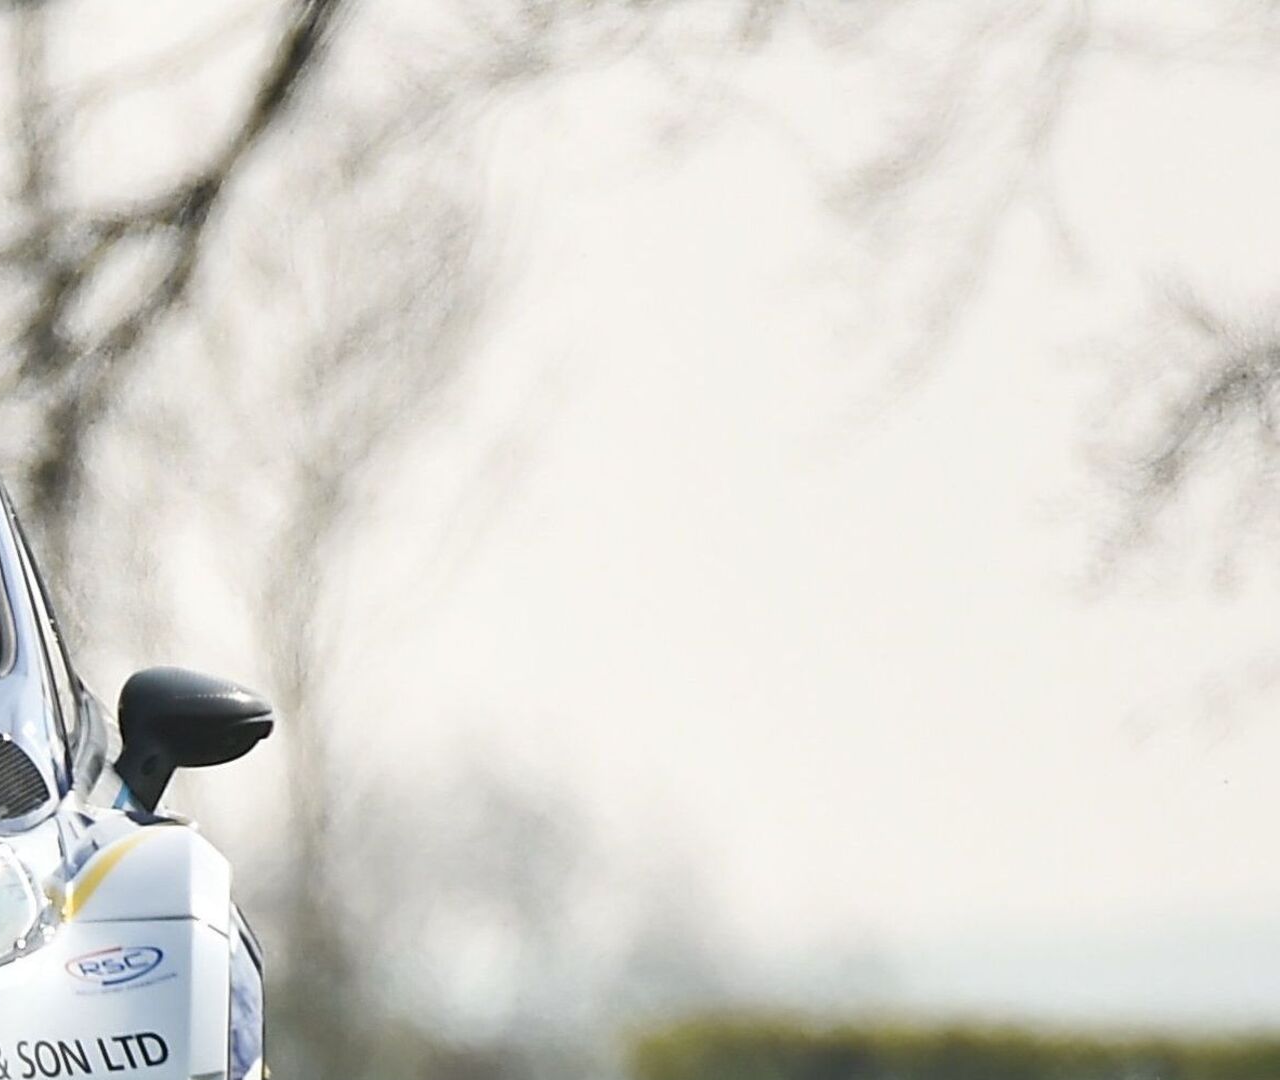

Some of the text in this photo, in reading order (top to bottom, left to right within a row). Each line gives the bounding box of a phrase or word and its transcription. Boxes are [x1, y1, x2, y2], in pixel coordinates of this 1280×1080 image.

[78, 951, 151, 976] RSC
[16, 1037, 93, 1079] SON
[96, 1031, 170, 1073] LTD
